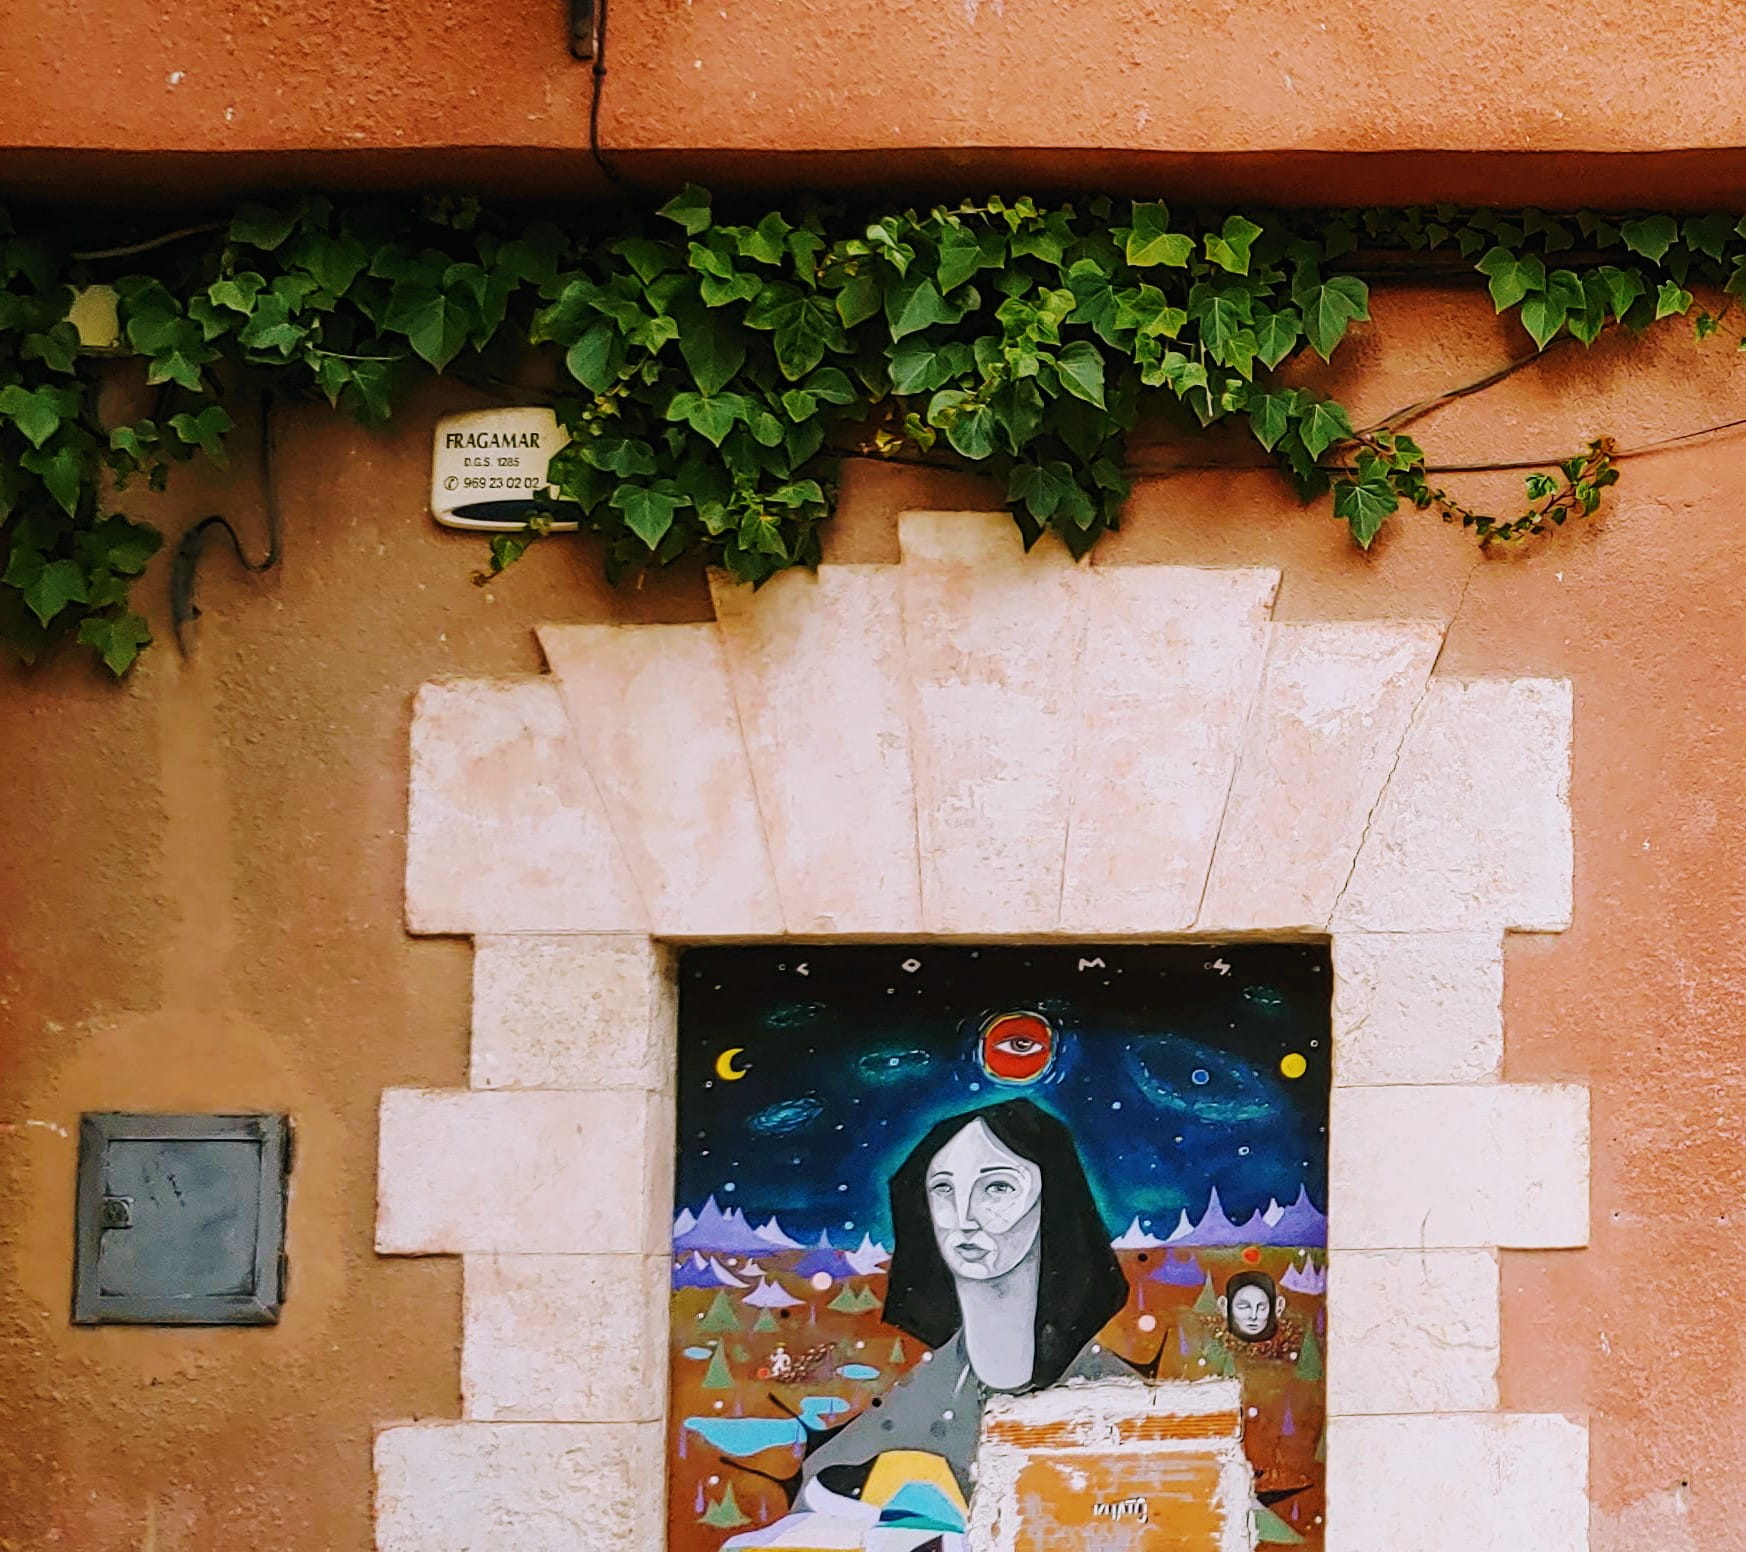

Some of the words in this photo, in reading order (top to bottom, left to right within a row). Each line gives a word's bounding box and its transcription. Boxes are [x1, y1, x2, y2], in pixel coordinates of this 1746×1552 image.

[446, 432, 541, 449] FRAGAMAR
[463, 477, 486, 489] 969
[489, 477, 504, 489] 23
[506, 477, 521, 489] 02
[524, 477, 540, 489] 02
